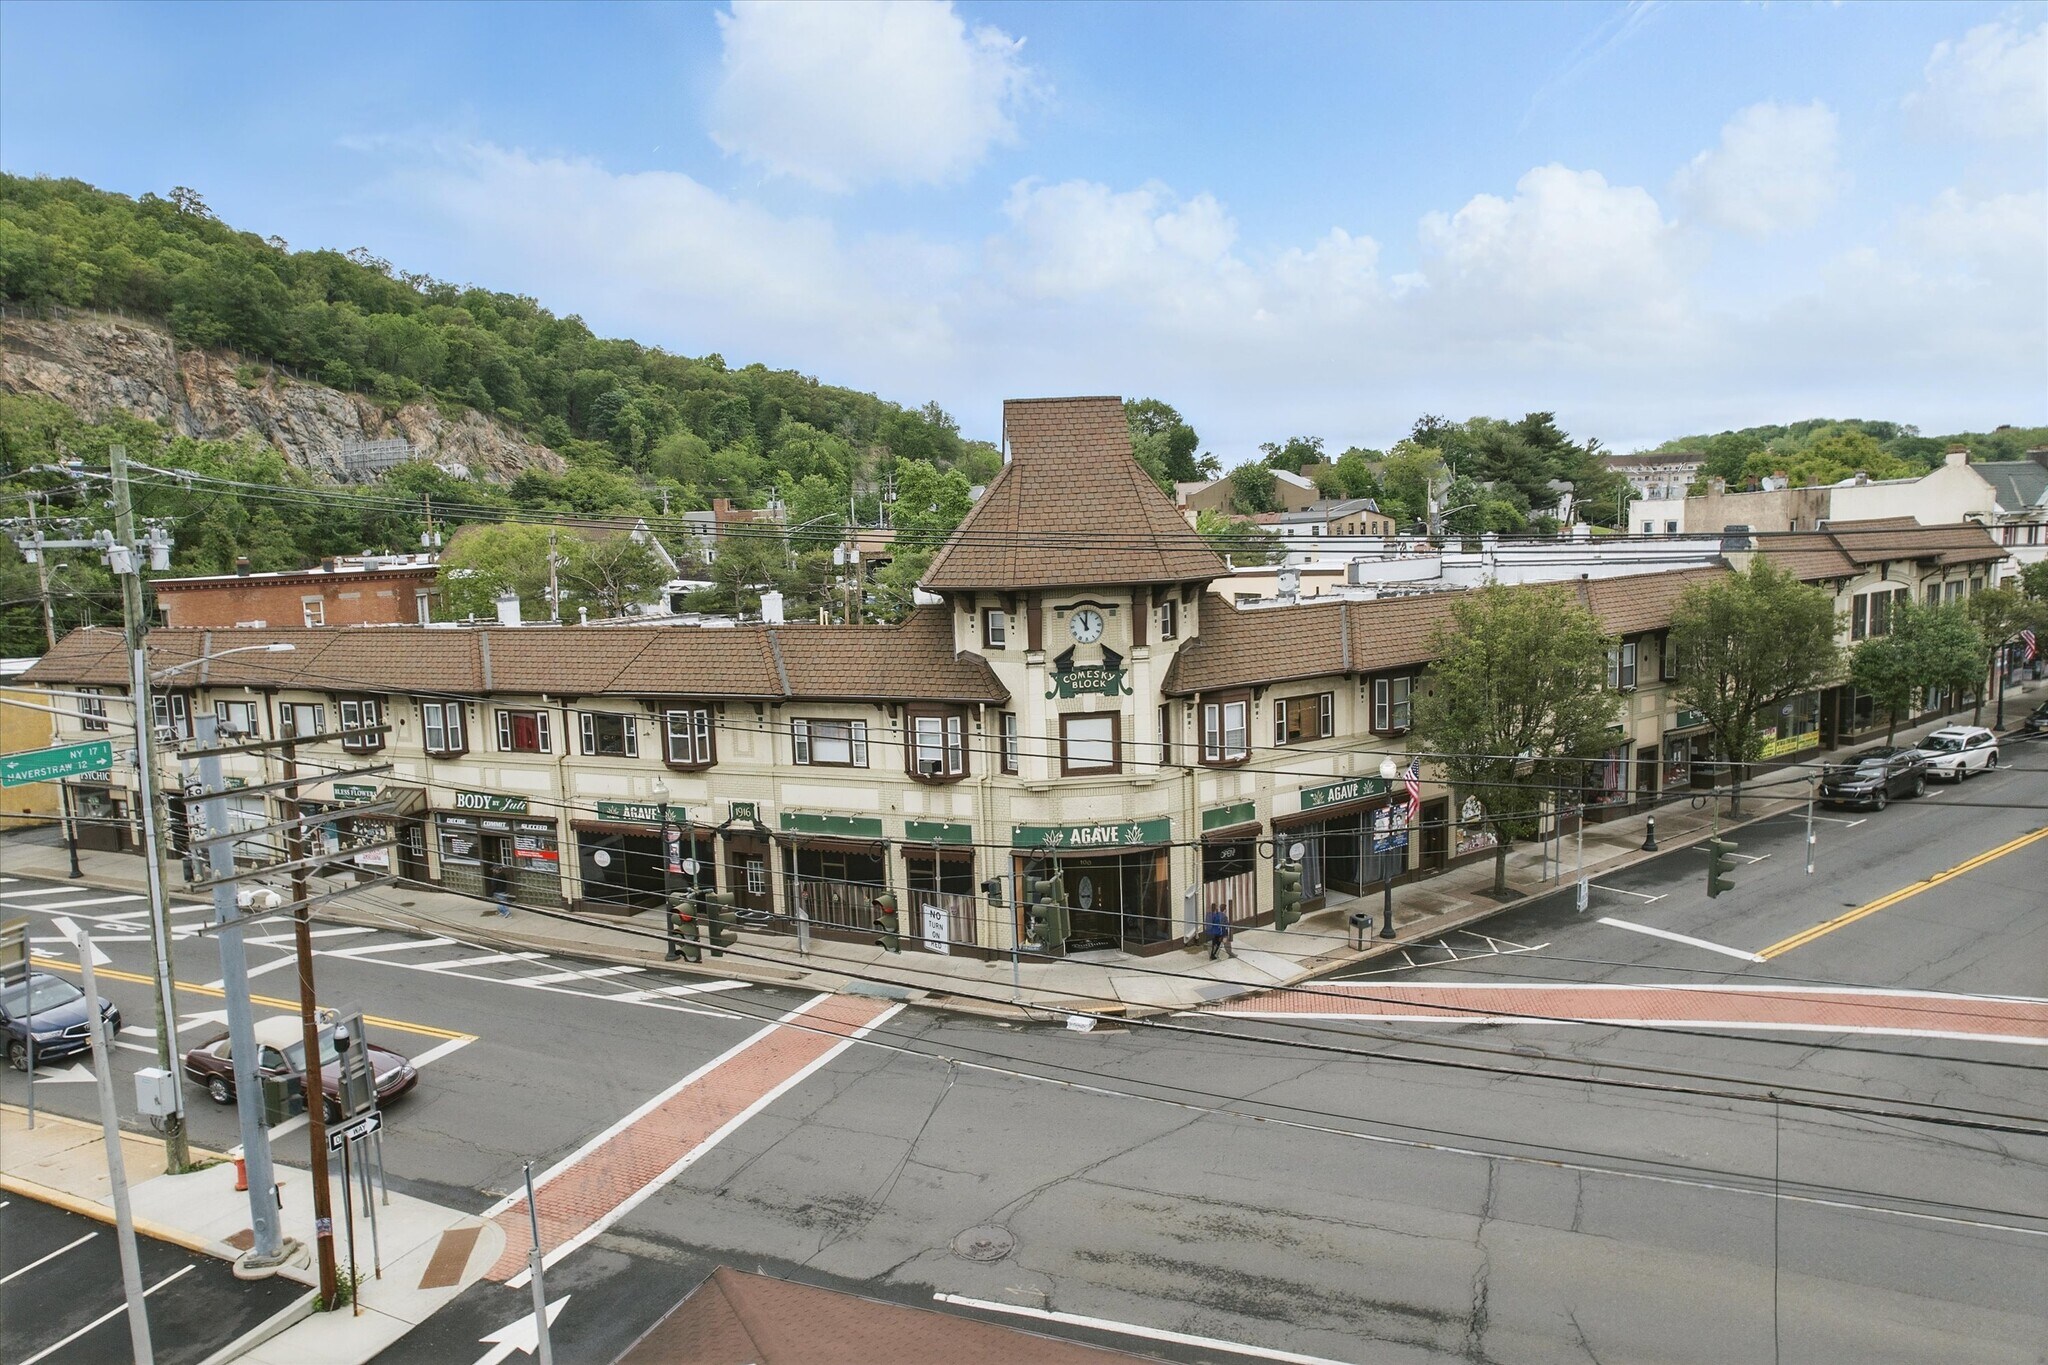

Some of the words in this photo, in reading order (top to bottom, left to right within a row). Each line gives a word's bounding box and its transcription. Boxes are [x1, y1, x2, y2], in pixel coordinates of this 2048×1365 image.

[1063, 670, 1116, 684] COMESKY
[1072, 680, 1106, 688] BLOCK
[70, 750, 83, 759] NY
[89, 747, 97, 756] 17
[7, 763, 72, 782] HAVERSTRAW
[78, 761, 88, 770] 12
[350, 788, 377, 797] FLOWERS
[1327, 783, 1359, 802] AGAVE
[457, 793, 492, 810] BODY
[499, 798, 527, 812] Juli
[735, 806, 751, 818] 1916
[483, 820, 506, 828] COMMIT
[521, 823, 548, 831] SUCCEED
[1070, 826, 1119, 845] AGAVE
[930, 910, 942, 921] NO
[929, 920, 943, 931] TURN
[932, 931, 940, 939] ON
[931, 941, 942, 950] RED
[353, 1124, 366, 1135] WAY
